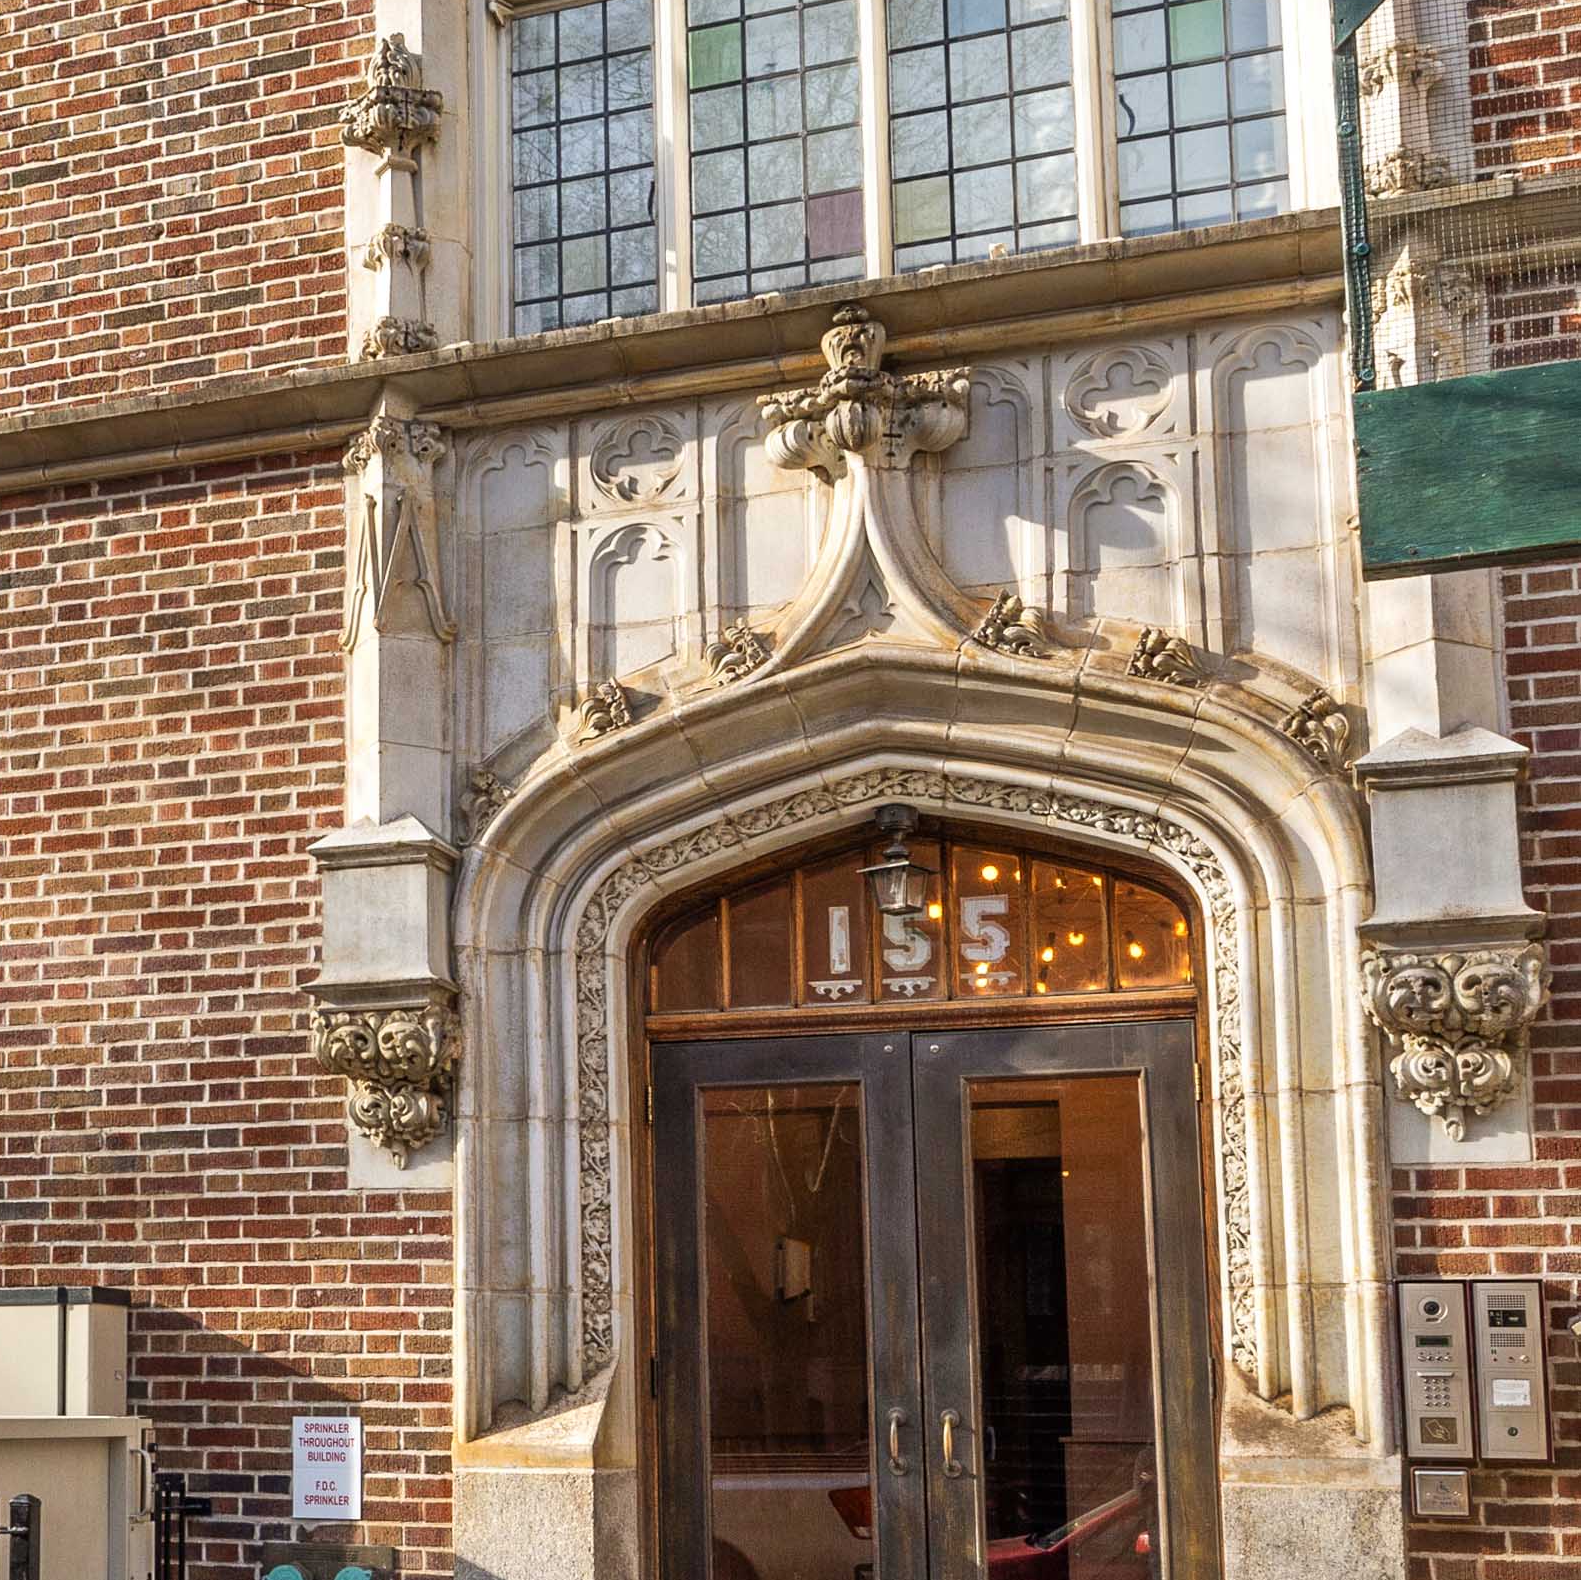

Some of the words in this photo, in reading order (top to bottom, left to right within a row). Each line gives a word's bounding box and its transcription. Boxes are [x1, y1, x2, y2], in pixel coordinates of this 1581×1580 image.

[828, 894, 1010, 975] 155
[304, 1422, 349, 1433] SPRINKLER
[298, 1437, 355, 1448] THROUGHOUT
[307, 1451, 346, 1462] BUILDING
[315, 1480, 338, 1491] F.D.C.
[304, 1495, 350, 1506] SPRINKLER
